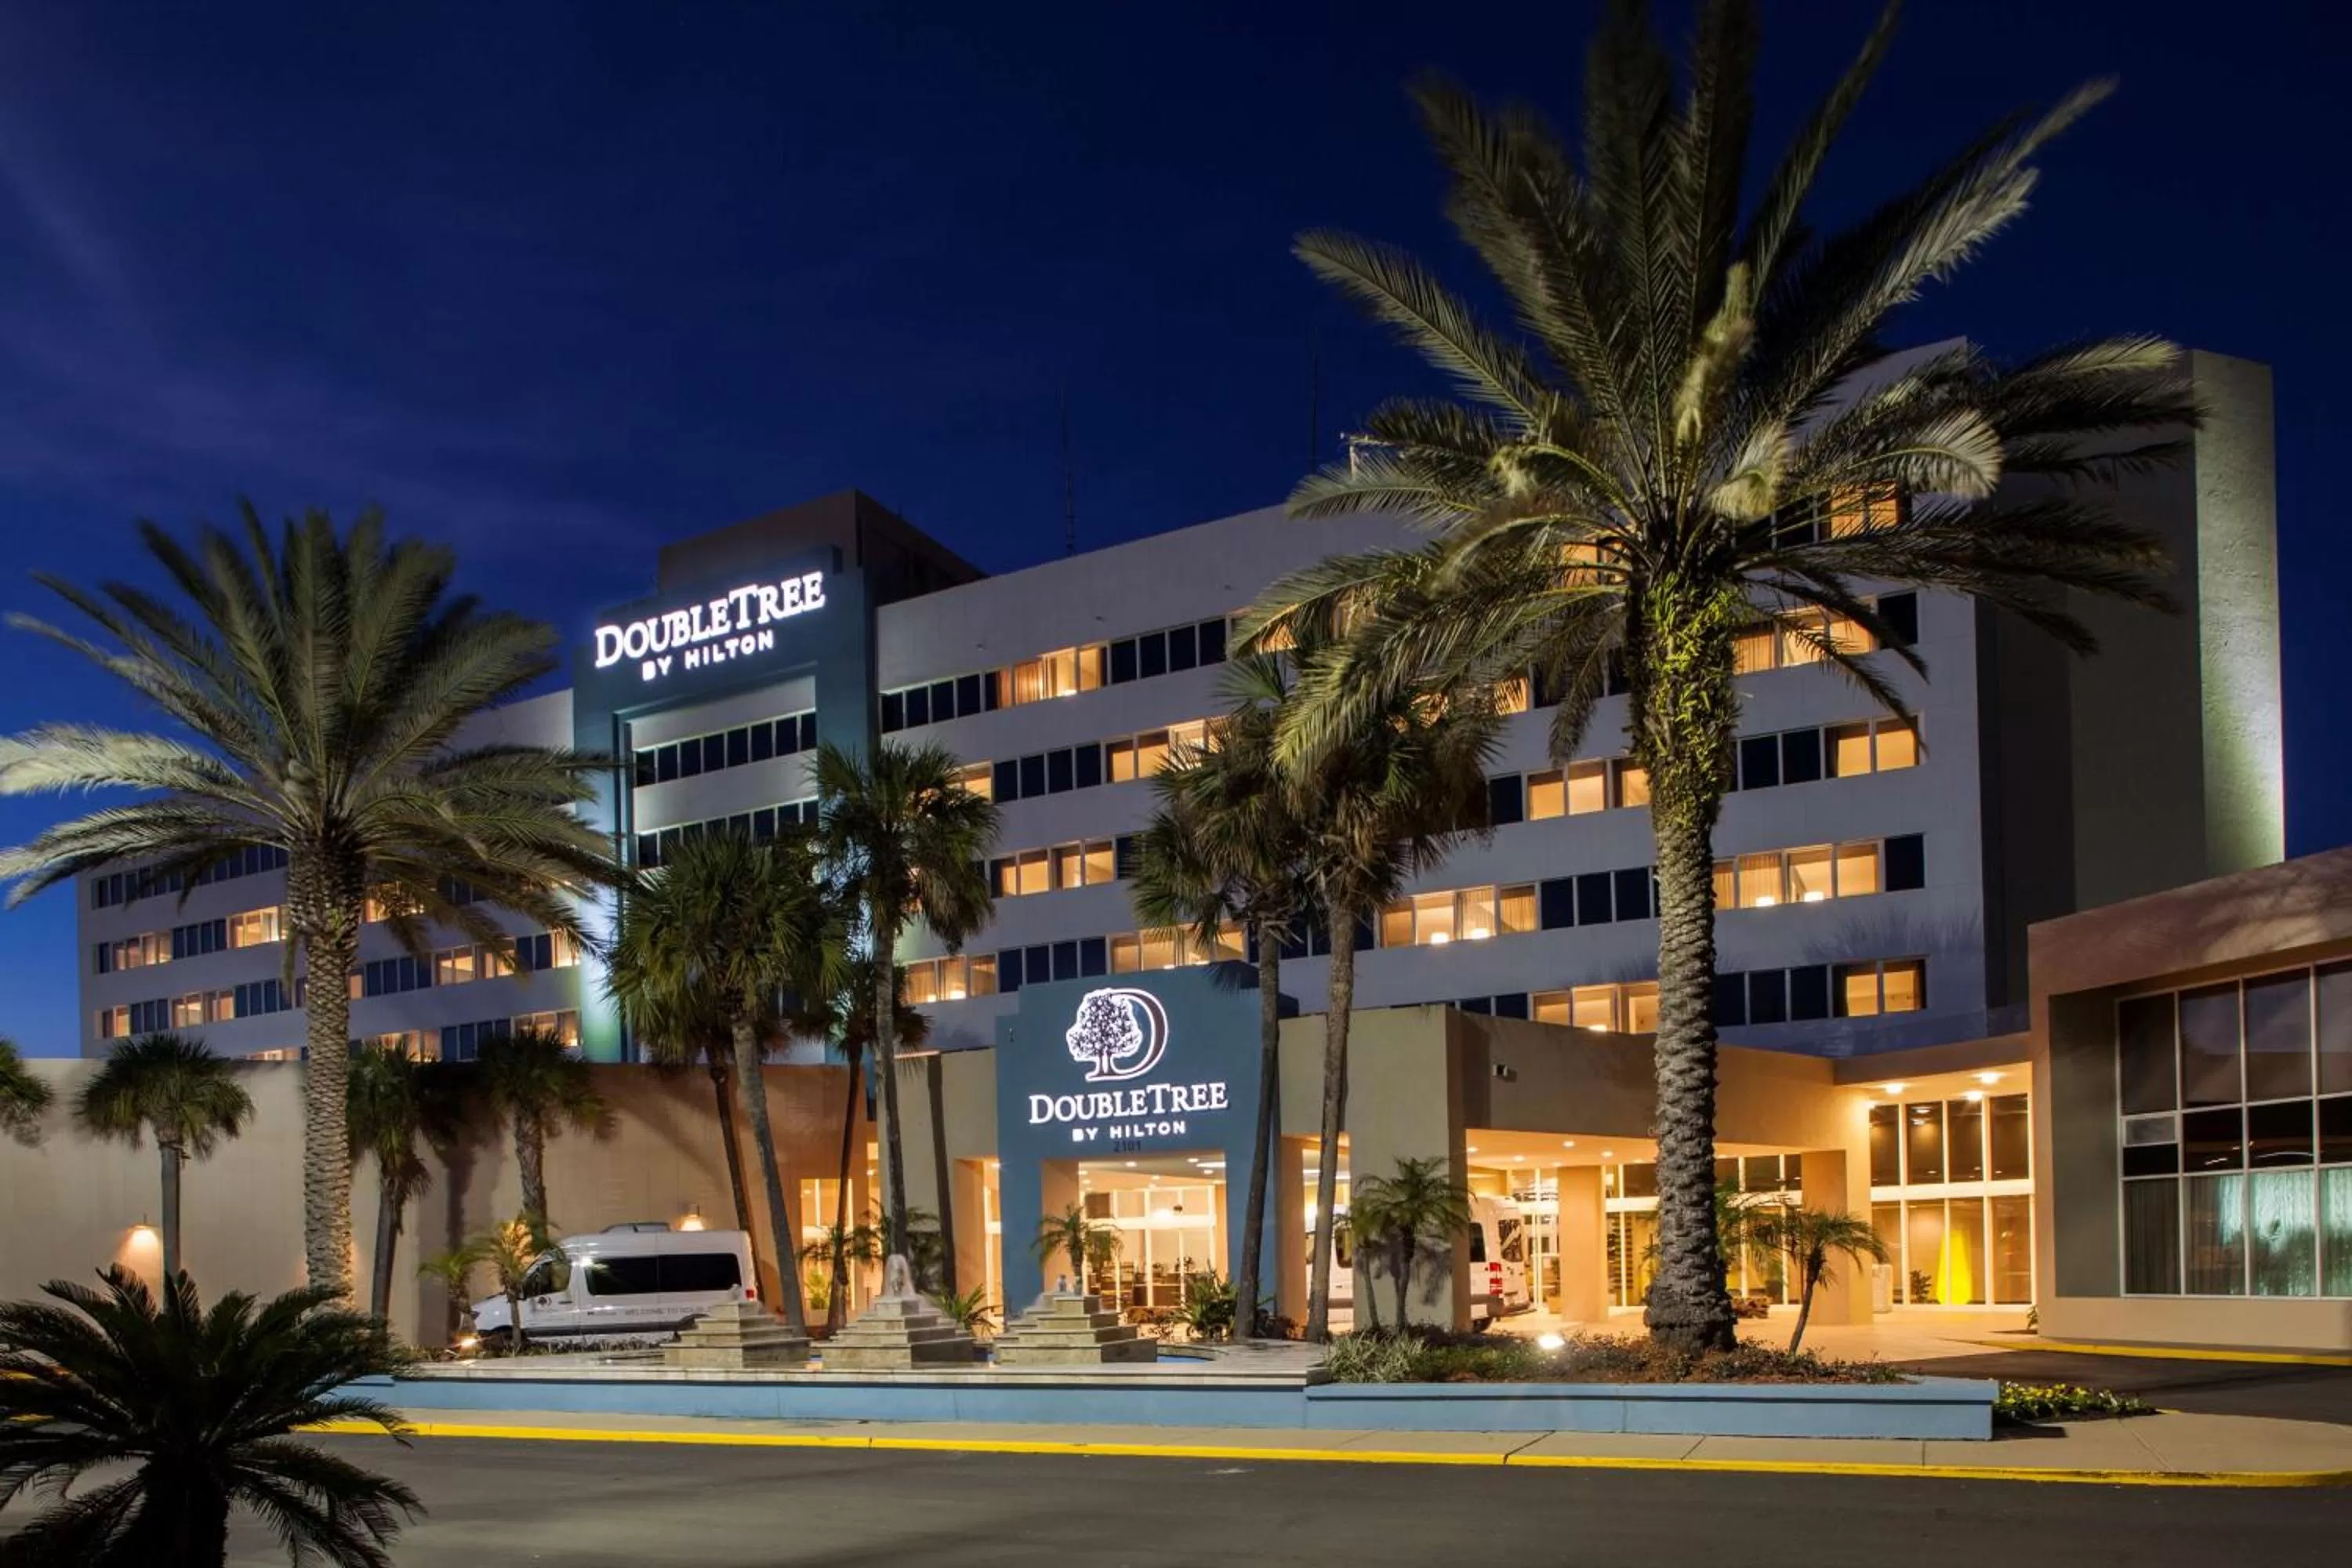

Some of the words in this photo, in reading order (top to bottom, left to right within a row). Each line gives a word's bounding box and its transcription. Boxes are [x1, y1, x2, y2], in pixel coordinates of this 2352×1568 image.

[595, 571, 826, 668] DOUBLETREE
[641, 655, 672, 681] BY
[684, 630, 775, 670] HILTON
[1029, 1082, 1229, 1123] DOUBLETREE
[1072, 1127, 1098, 1142] BY
[1109, 1120, 1186, 1139] HILTON
